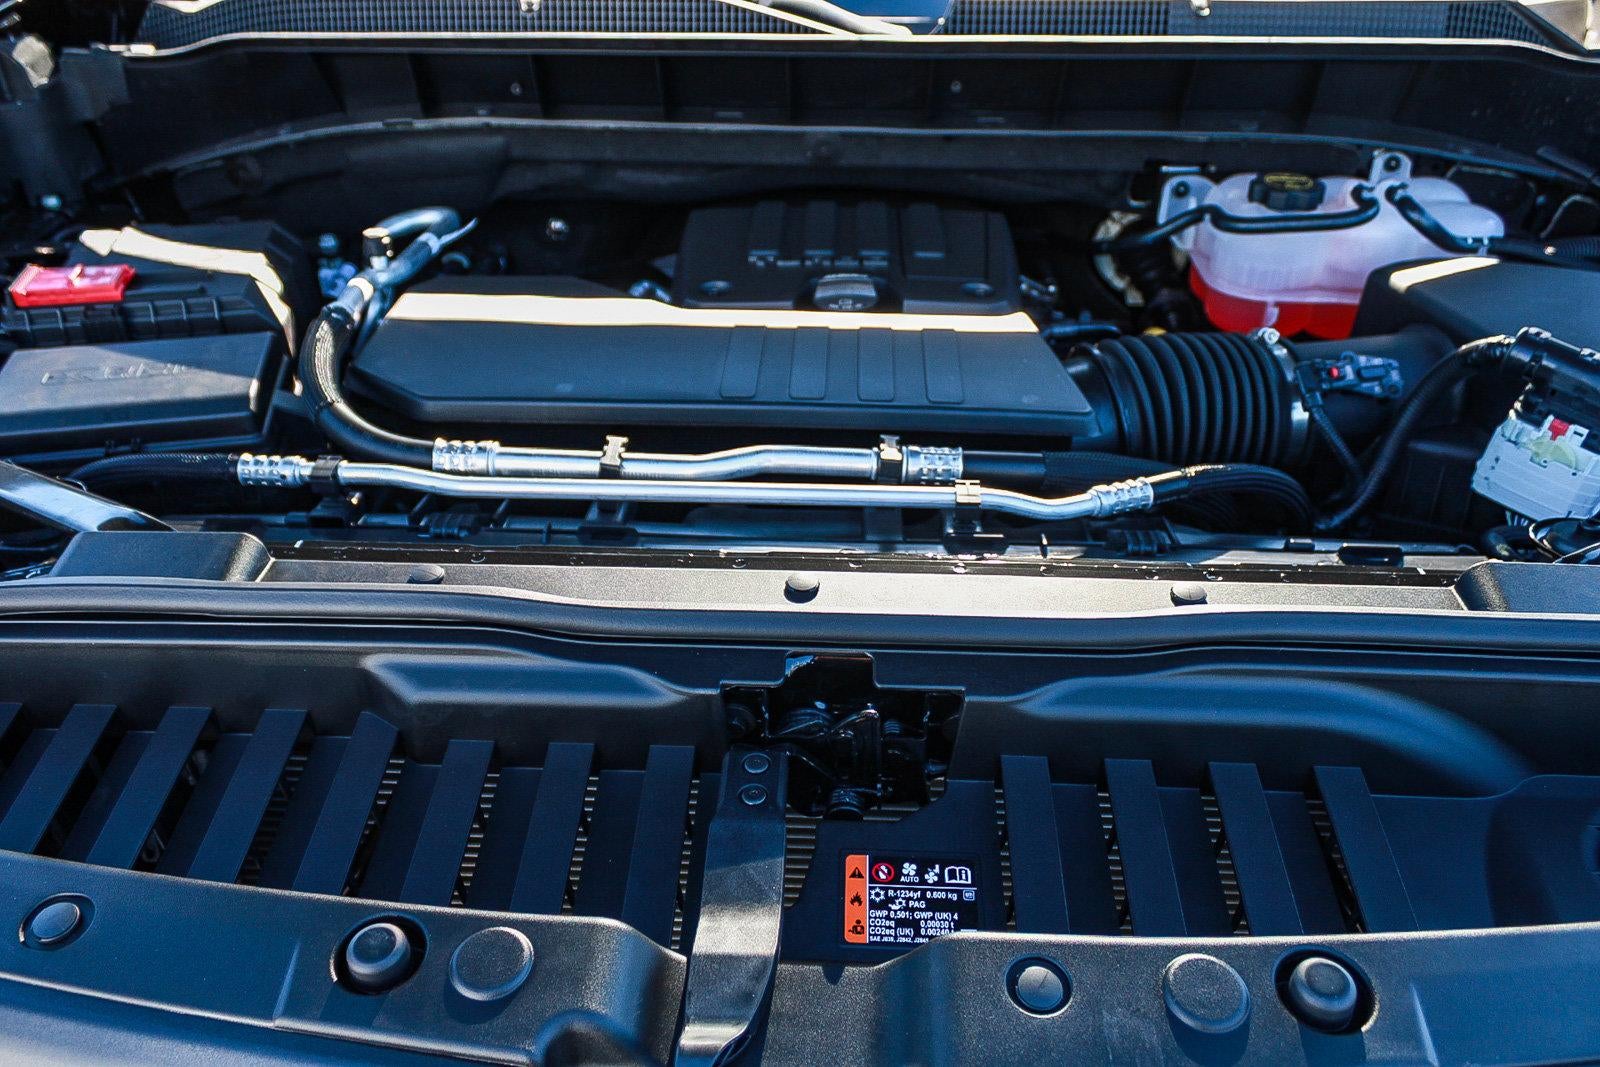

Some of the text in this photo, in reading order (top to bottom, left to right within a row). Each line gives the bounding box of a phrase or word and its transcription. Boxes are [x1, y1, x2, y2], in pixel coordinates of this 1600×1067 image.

[888, 889, 921, 899] R-1234yf
[948, 891, 957, 900] kg
[909, 900, 926, 908] PAG
[935, 912, 952, 921] (UK)
[869, 918, 895, 928] CO2eq
[869, 926, 895, 936] CO2eq
[897, 927, 914, 937] (UK)
